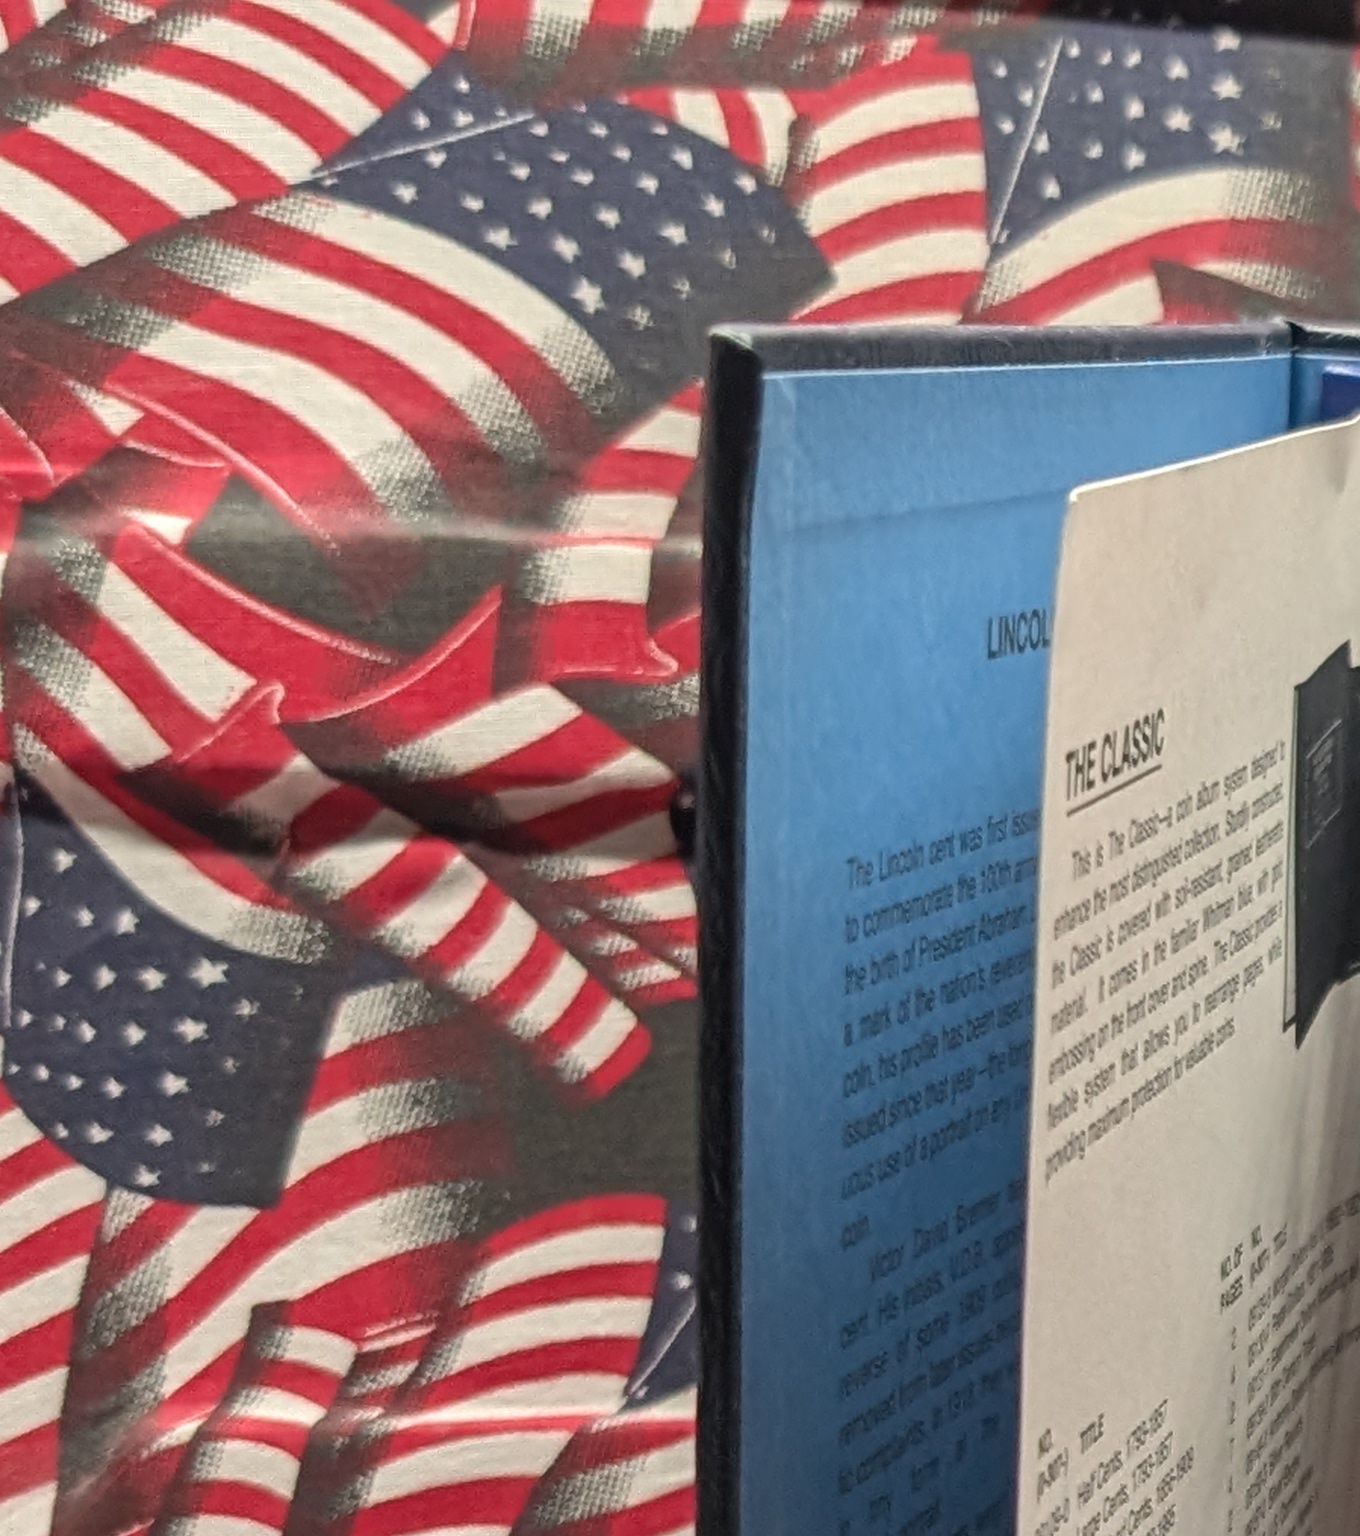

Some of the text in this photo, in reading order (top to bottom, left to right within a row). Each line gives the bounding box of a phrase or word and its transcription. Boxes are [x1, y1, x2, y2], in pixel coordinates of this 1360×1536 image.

[1065, 707, 1165, 801] THE CLASSIC
[878, 840, 924, 882] Lincoln
[929, 831, 954, 866] cent
[960, 826, 982, 854] was
[1072, 850, 1090, 879] This
[1095, 843, 1103, 868] is
[1108, 830, 1124, 859] The
[1093, 887, 1106, 915] the
[1110, 872, 1129, 904] most
[1132, 838, 1182, 892] distinguished
[957, 874, 976, 903] the
[844, 963, 866, 995] the
[918, 920, 976, 967] President
[1052, 891, 1170, 989] the Classic is covered with
[1108, 959, 1136, 996] comes
[1142, 949, 1149, 974] in
[1154, 940, 1167, 966] the
[914, 988, 934, 1018] the
[1048, 1032, 1094, 1084] embossing
[1098, 1022, 1108, 1049] on
[1110, 1012, 1123, 1039] the
[1148, 981, 1169, 1014] cover
[1172, 965, 1186, 998] and
[1213, 939, 1226, 965] The
[1230, 923, 1252, 956] Classic
[1084, 1062, 1114, 1104] system
[1120, 1042, 1138, 1075] that
[1131, 1065, 1171, 1120] protection
[1097, 1450, 1122, 1489] Cents
[1103, 1484, 1128, 1523] Cents
[1128, 1497, 1152, 1536] Cents
